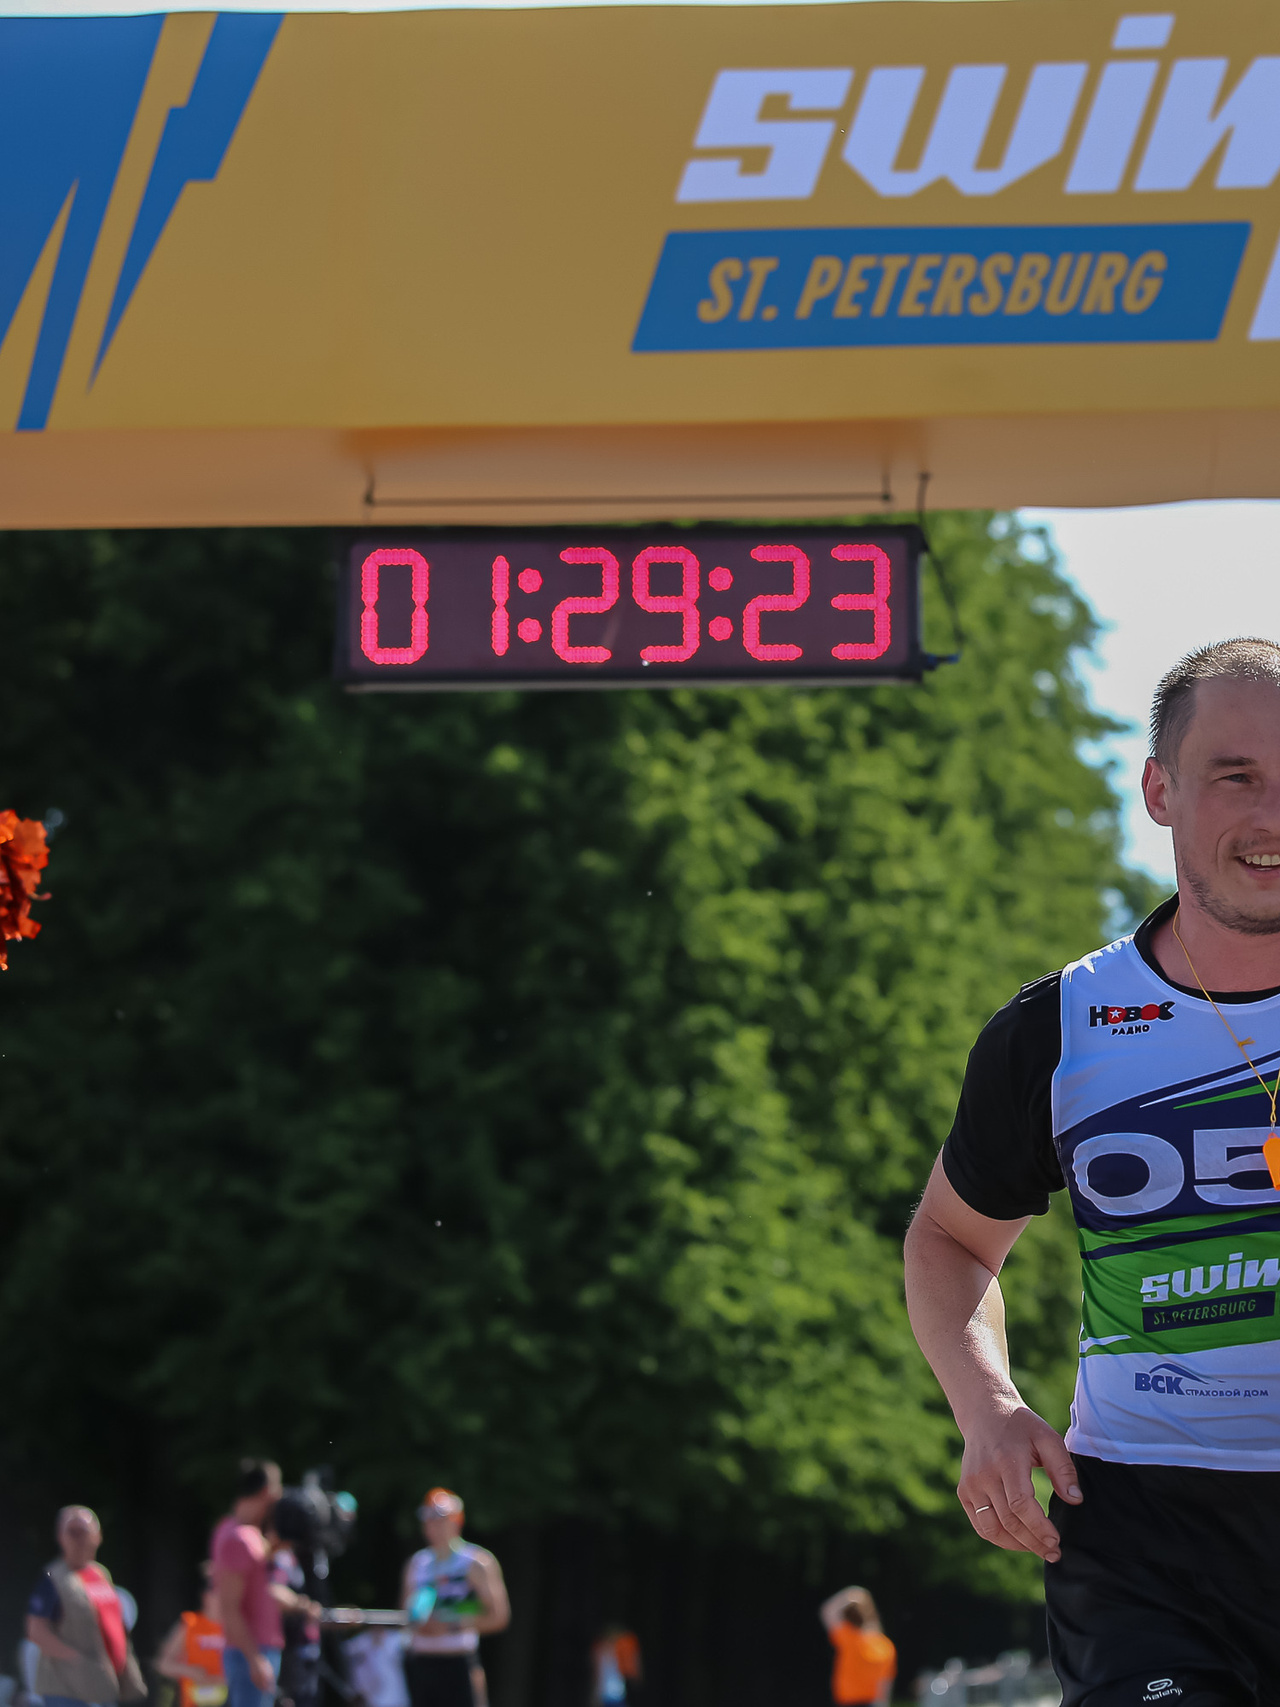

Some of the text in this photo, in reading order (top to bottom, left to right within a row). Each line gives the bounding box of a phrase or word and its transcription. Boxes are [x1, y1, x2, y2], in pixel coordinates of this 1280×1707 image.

[695, 250, 1167, 322] ST. PETERSBURG
[361, 544, 891, 665] 01:29:23
[1111, 1024, 1150, 1035] РАДИО
[1153, 1299, 1256, 1326] ST. PETERSBURG
[1134, 1372, 1185, 1395] ВСК
[1185, 1389, 1269, 1398] СТРАХОВОЙ ДОМ
